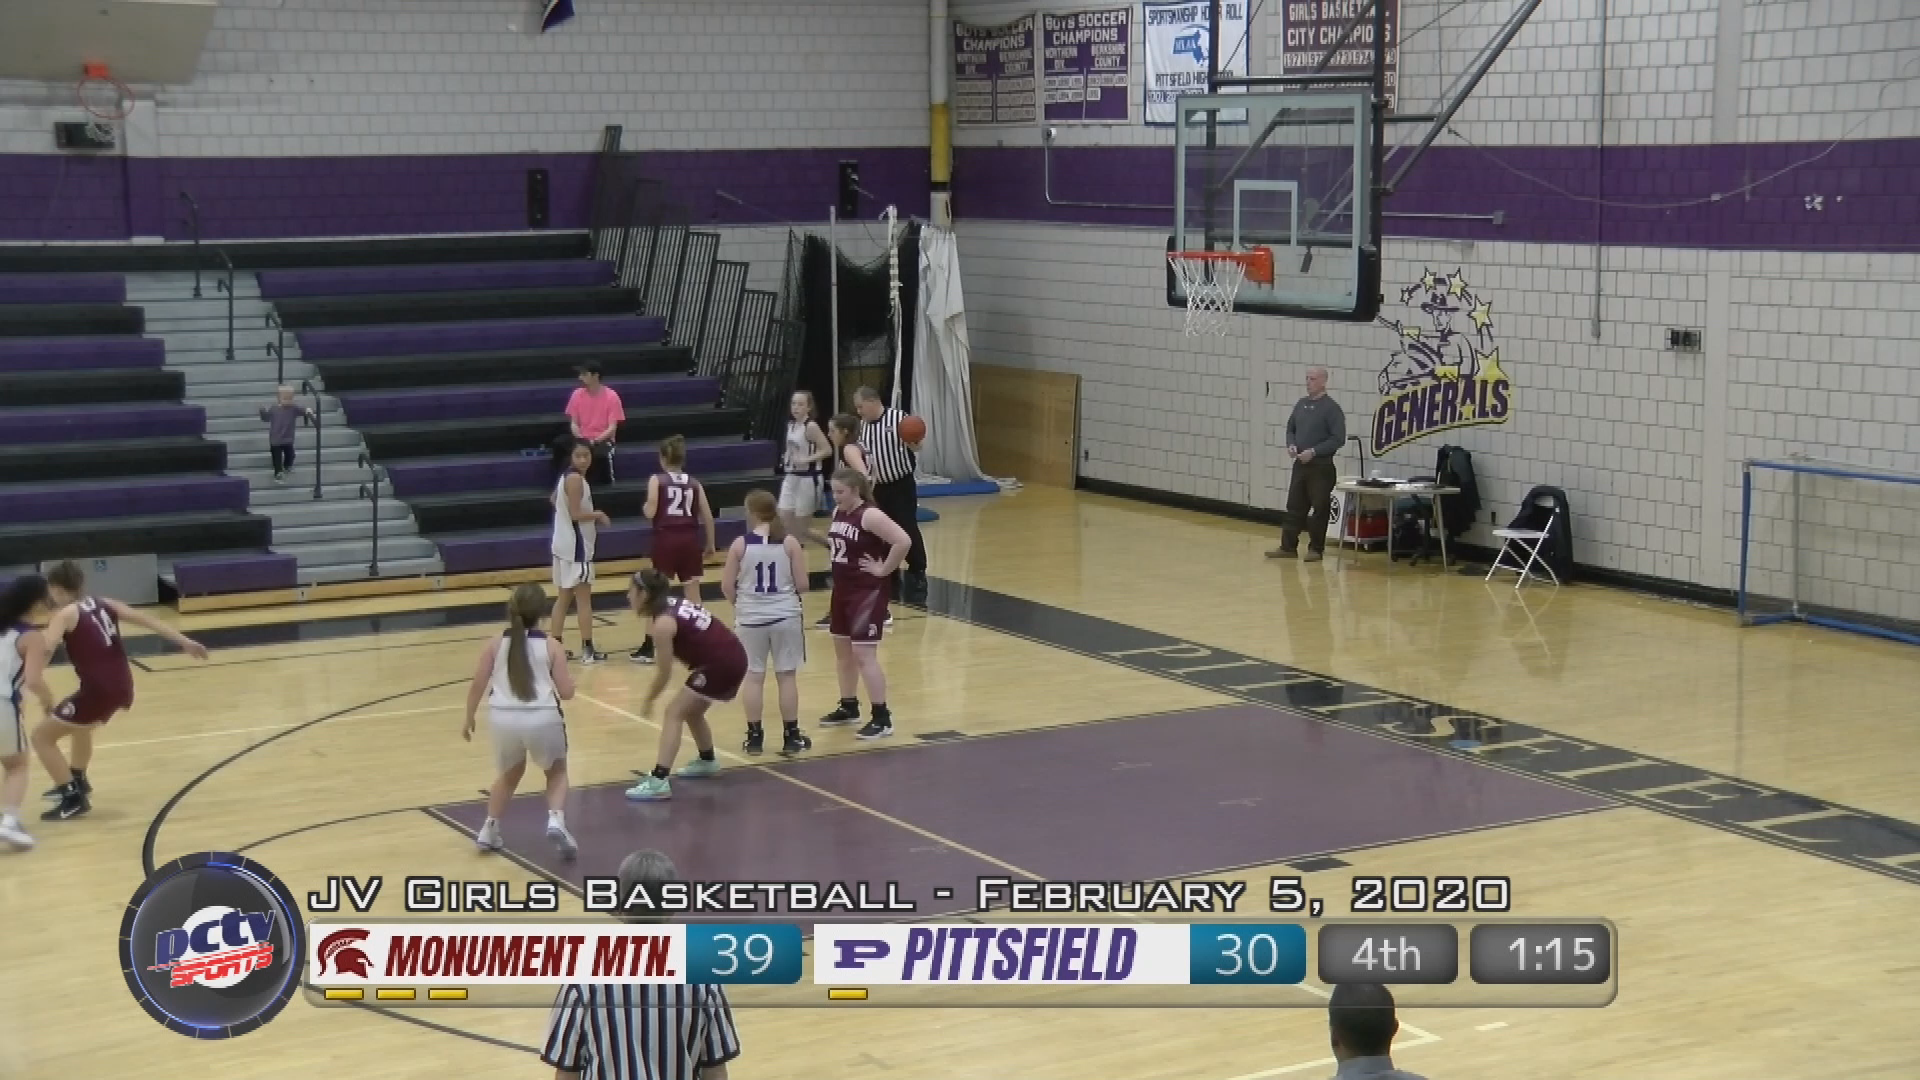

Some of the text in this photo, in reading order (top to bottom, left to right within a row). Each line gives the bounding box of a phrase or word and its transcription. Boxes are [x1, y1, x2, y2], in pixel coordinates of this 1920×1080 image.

[1045, 11, 1127, 30] BOYS SOCCER
[1225, 3, 1243, 20] ROLL
[1289, 3, 1318, 21] GIRLS
[963, 35, 1025, 51] CHAMPIONS
[1053, 28, 1118, 45] CHAMPIONS
[1287, 27, 1316, 46] CITY
[1094, 56, 1120, 68] COUNTY
[1155, 72, 1191, 87] PITTSFIELD
[1374, 379, 1510, 452] GENERALS
[667, 486, 695, 516] 21
[754, 561, 778, 592] 11
[90, 607, 118, 646] 14
